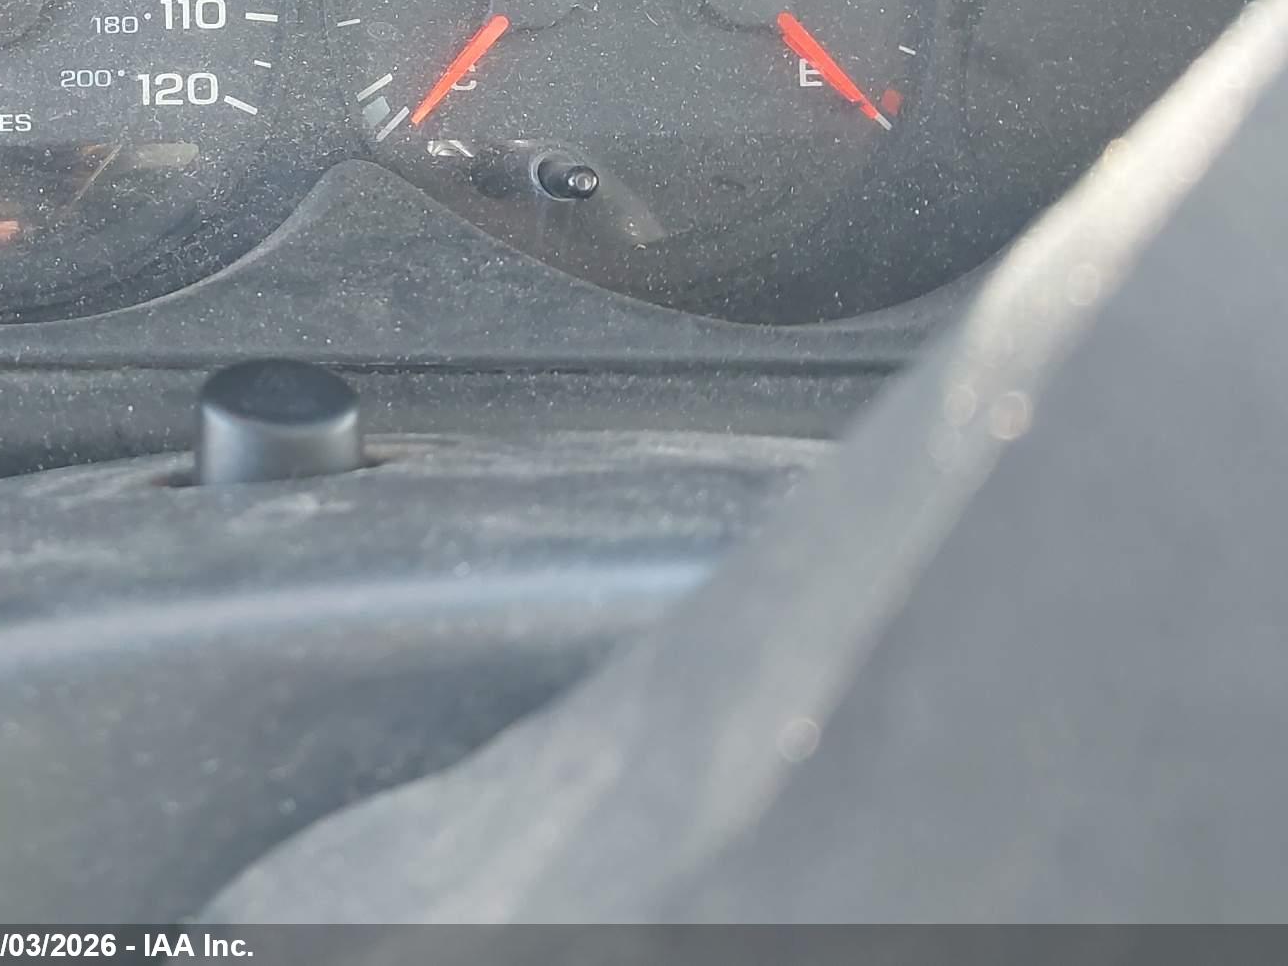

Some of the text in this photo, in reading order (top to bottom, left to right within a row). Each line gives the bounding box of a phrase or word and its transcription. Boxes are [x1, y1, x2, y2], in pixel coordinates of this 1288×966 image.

[94, 15, 139, 34] 180
[60, 68, 112, 88] 200
[136, 72, 218, 106] 120
